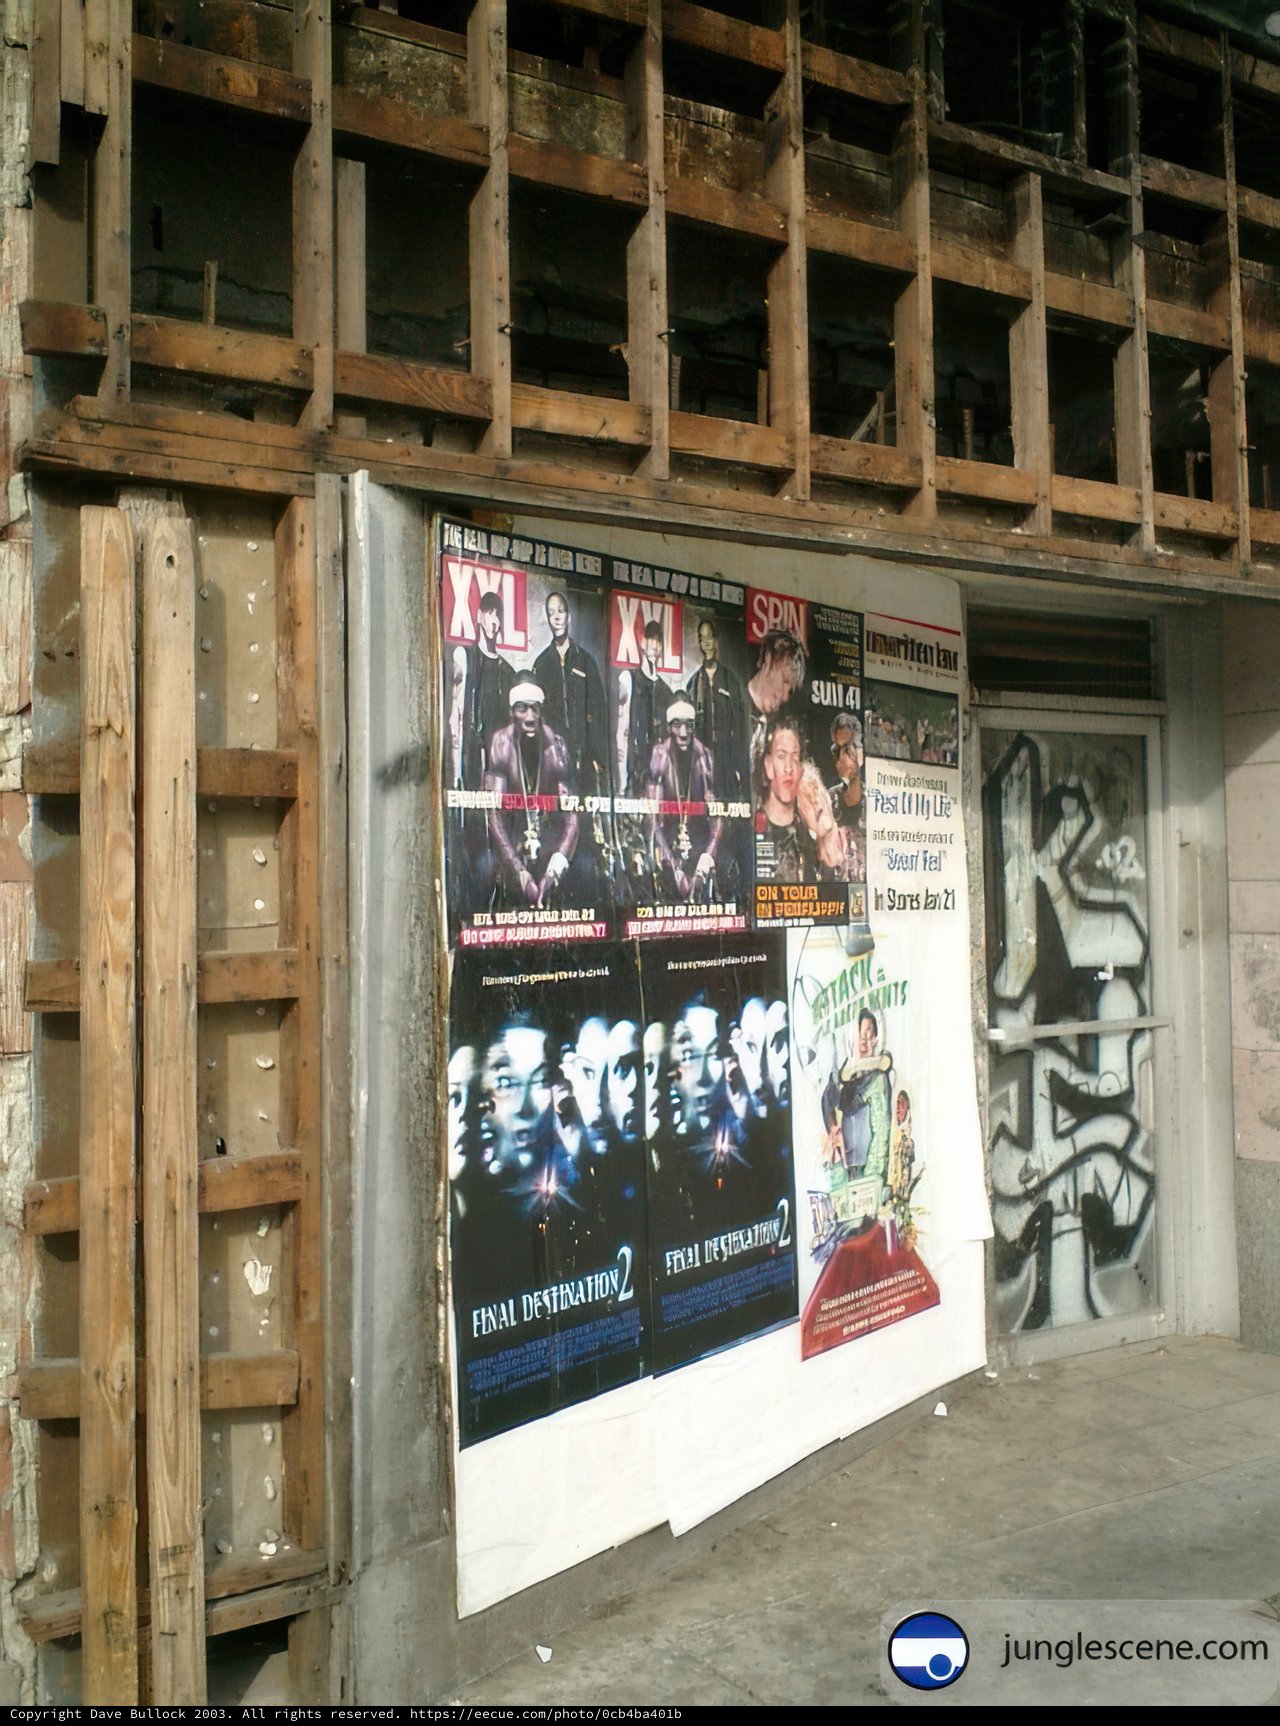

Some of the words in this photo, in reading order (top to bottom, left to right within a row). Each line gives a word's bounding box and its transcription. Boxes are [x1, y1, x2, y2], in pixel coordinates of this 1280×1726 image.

[447, 561, 525, 647] XXL
[616, 595, 681, 670] XXL
[776, 1198, 791, 1248] 2
[472, 1299, 517, 1338] FINAL
[522, 1269, 620, 1321] DESTINATION
[617, 1245, 634, 1301] 2
